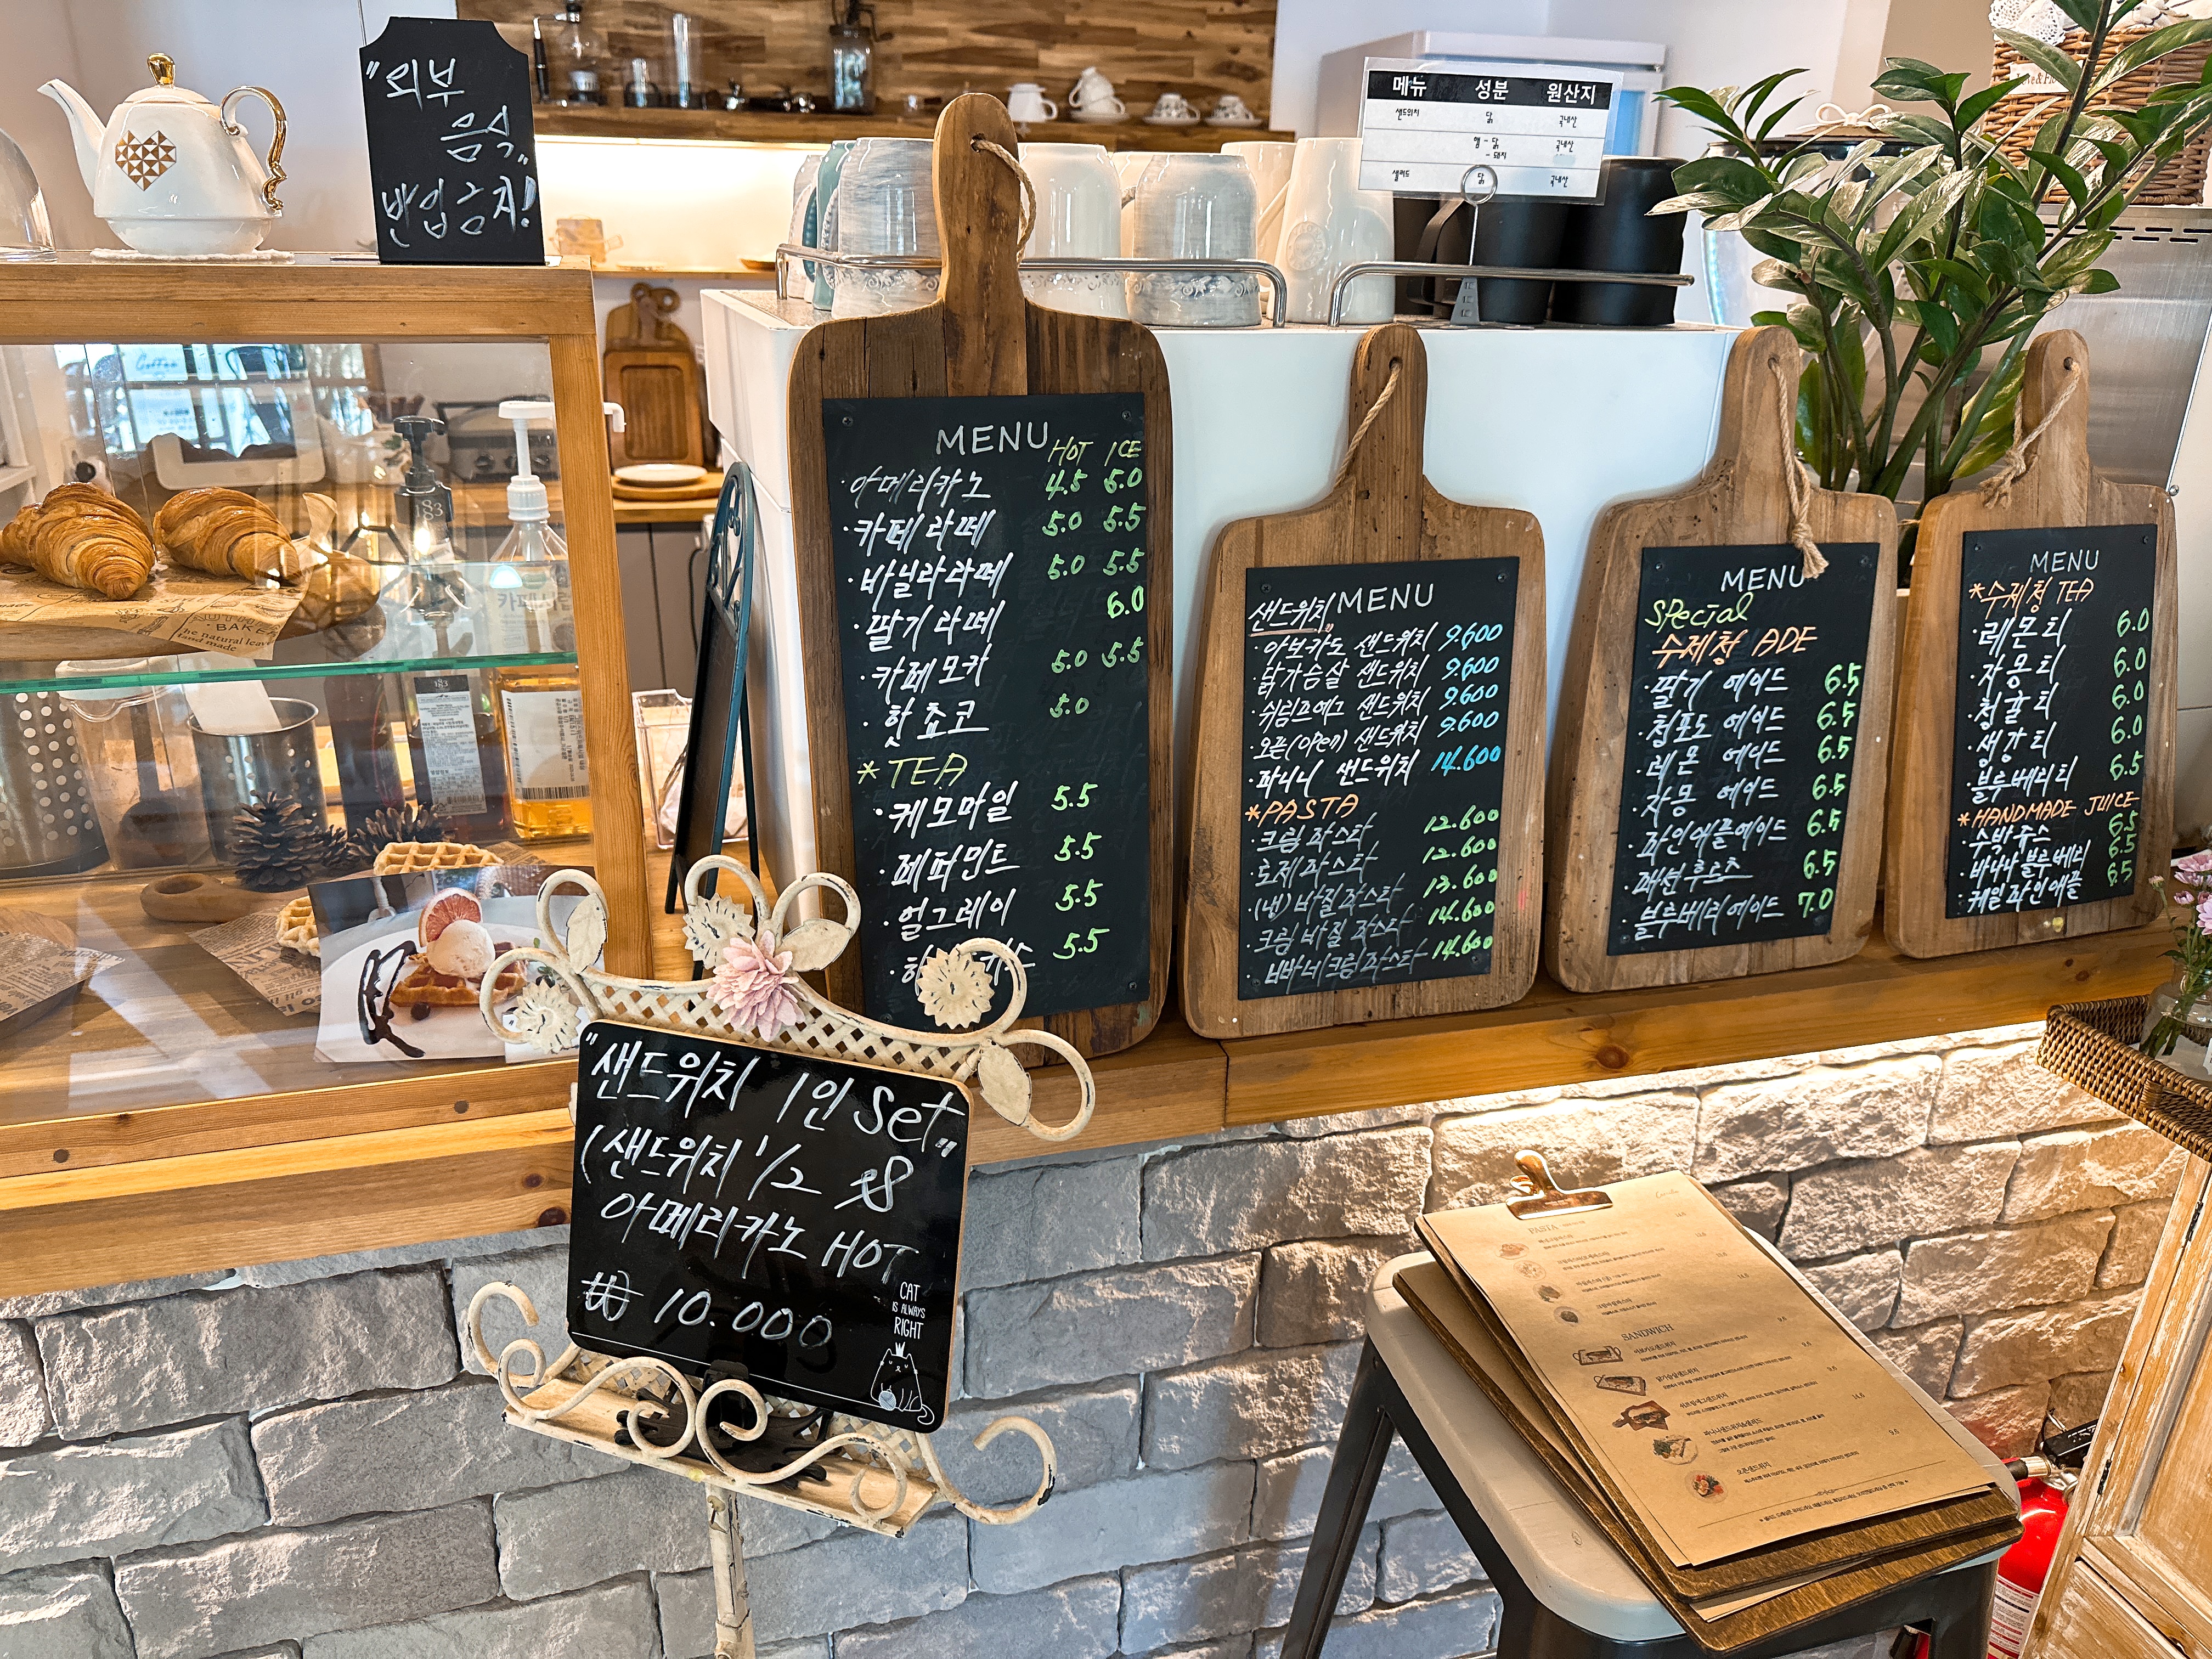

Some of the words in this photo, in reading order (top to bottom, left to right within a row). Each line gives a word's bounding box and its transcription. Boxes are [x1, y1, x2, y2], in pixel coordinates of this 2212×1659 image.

[1393, 76, 1426, 98] 메뉴
[1475, 80, 1509, 101] 성분
[1547, 82, 1596, 105] 원산지
[1395, 108, 1420, 121] 샌드위치
[1559, 115, 1577, 128] 국내산
[1556, 140, 1574, 153] 국내산
[1550, 174, 1568, 188] 국내산
[936, 421, 1048, 456] MENU
[1048, 437, 1093, 466] HOT
[1104, 439, 1142, 466] ICE
[850, 466, 991, 512] 아메리카노
[1045, 469, 1088, 500] 4.5
[1042, 510, 1082, 537] 5.0
[1103, 502, 1146, 532] 5.5
[1047, 554, 1085, 580] 5.0
[1103, 548, 1145, 576] 5.5
[2029, 549, 2099, 573] MENU
[1720, 565, 1805, 592] MENU
[2057, 577, 2095, 604] TEA
[1107, 585, 1144, 619] 6.0
[1337, 583, 1434, 614] MENU
[2117, 607, 2149, 637] 6.0
[1051, 650, 1087, 674] 5.0
[1101, 636, 1143, 668] 5.5
[1263, 634, 1346, 666] 아보카도
[1353, 622, 1438, 658] 샌드위치
[1437, 622, 1503, 652] 9.600
[1652, 628, 1749, 670] 수제청
[1751, 626, 1818, 657] ADE
[1257, 657, 1350, 700] 닭가슴살
[1356, 654, 1430, 689] 샌드위치
[1441, 656, 1499, 681] 9.600
[2114, 647, 2146, 678] 6.0
[1356, 686, 1432, 720] 샌드위치
[1438, 683, 1498, 711] 9.600
[1650, 669, 1713, 712] 딸기
[1723, 667, 1788, 702] 에이드
[1824, 662, 1861, 697] 6.5
[2112, 680, 2144, 710] 6.0
[1049, 693, 1089, 718] 5.0
[1353, 715, 1429, 753] 샌드위치
[1437, 711, 1499, 738] 9.600
[1646, 709, 1712, 748] 청포도
[1723, 704, 1785, 740] 에이드
[1817, 701, 1857, 730] 6.5
[2111, 714, 2142, 744] 6.0
[1256, 759, 1324, 800] 파니니
[1335, 748, 1420, 787] 샌드위치
[1430, 745, 1502, 776] 14.600
[1646, 745, 1699, 795] 레몬
[1723, 740, 1786, 772] 에이드
[1817, 734, 1853, 764] 6.5
[2109, 751, 2143, 781] 6.5
[888, 780, 1019, 839] 케모마일
[1051, 782, 1098, 811] 5.5
[1640, 783, 1696, 828] 자몽
[1717, 776, 1779, 809] 에이드
[1812, 772, 1846, 800] 6.5
[2084, 791, 2140, 816] JUICE
[1423, 805, 1499, 833] 12.600
[1807, 808, 1842, 837] 6.5
[2108, 810, 2138, 838] 6.5
[1423, 835, 1497, 864] 12.600
[2108, 833, 2137, 859] 6.5
[891, 838, 1020, 893] 페퍼민트
[1054, 832, 1102, 861] 5.5
[1803, 849, 1837, 879] 6.5
[1423, 864, 1497, 898] 13.600
[898, 888, 1017, 941] 얼그레이
[1056, 878, 1103, 911] 5.5
[1428, 896, 1495, 926] 14.600
[1798, 887, 1833, 918] 7.0
[1052, 927, 1110, 960] 5.5
[1431, 929, 1493, 961] 14.600
[600, 1192, 808, 1280] 아메리카노
[821, 1229, 920, 1284] HOT
[1528, 1224, 1559, 1234] PASTA
[900, 1282, 921, 1302] CAT
[654, 1288, 834, 1348] 10.000
[892, 1301, 898, 1312] IS
[901, 1303, 926, 1318] ALWAYS
[894, 1317, 924, 1339] RIGHT
[1621, 1323, 1674, 1341] SANDWICH
